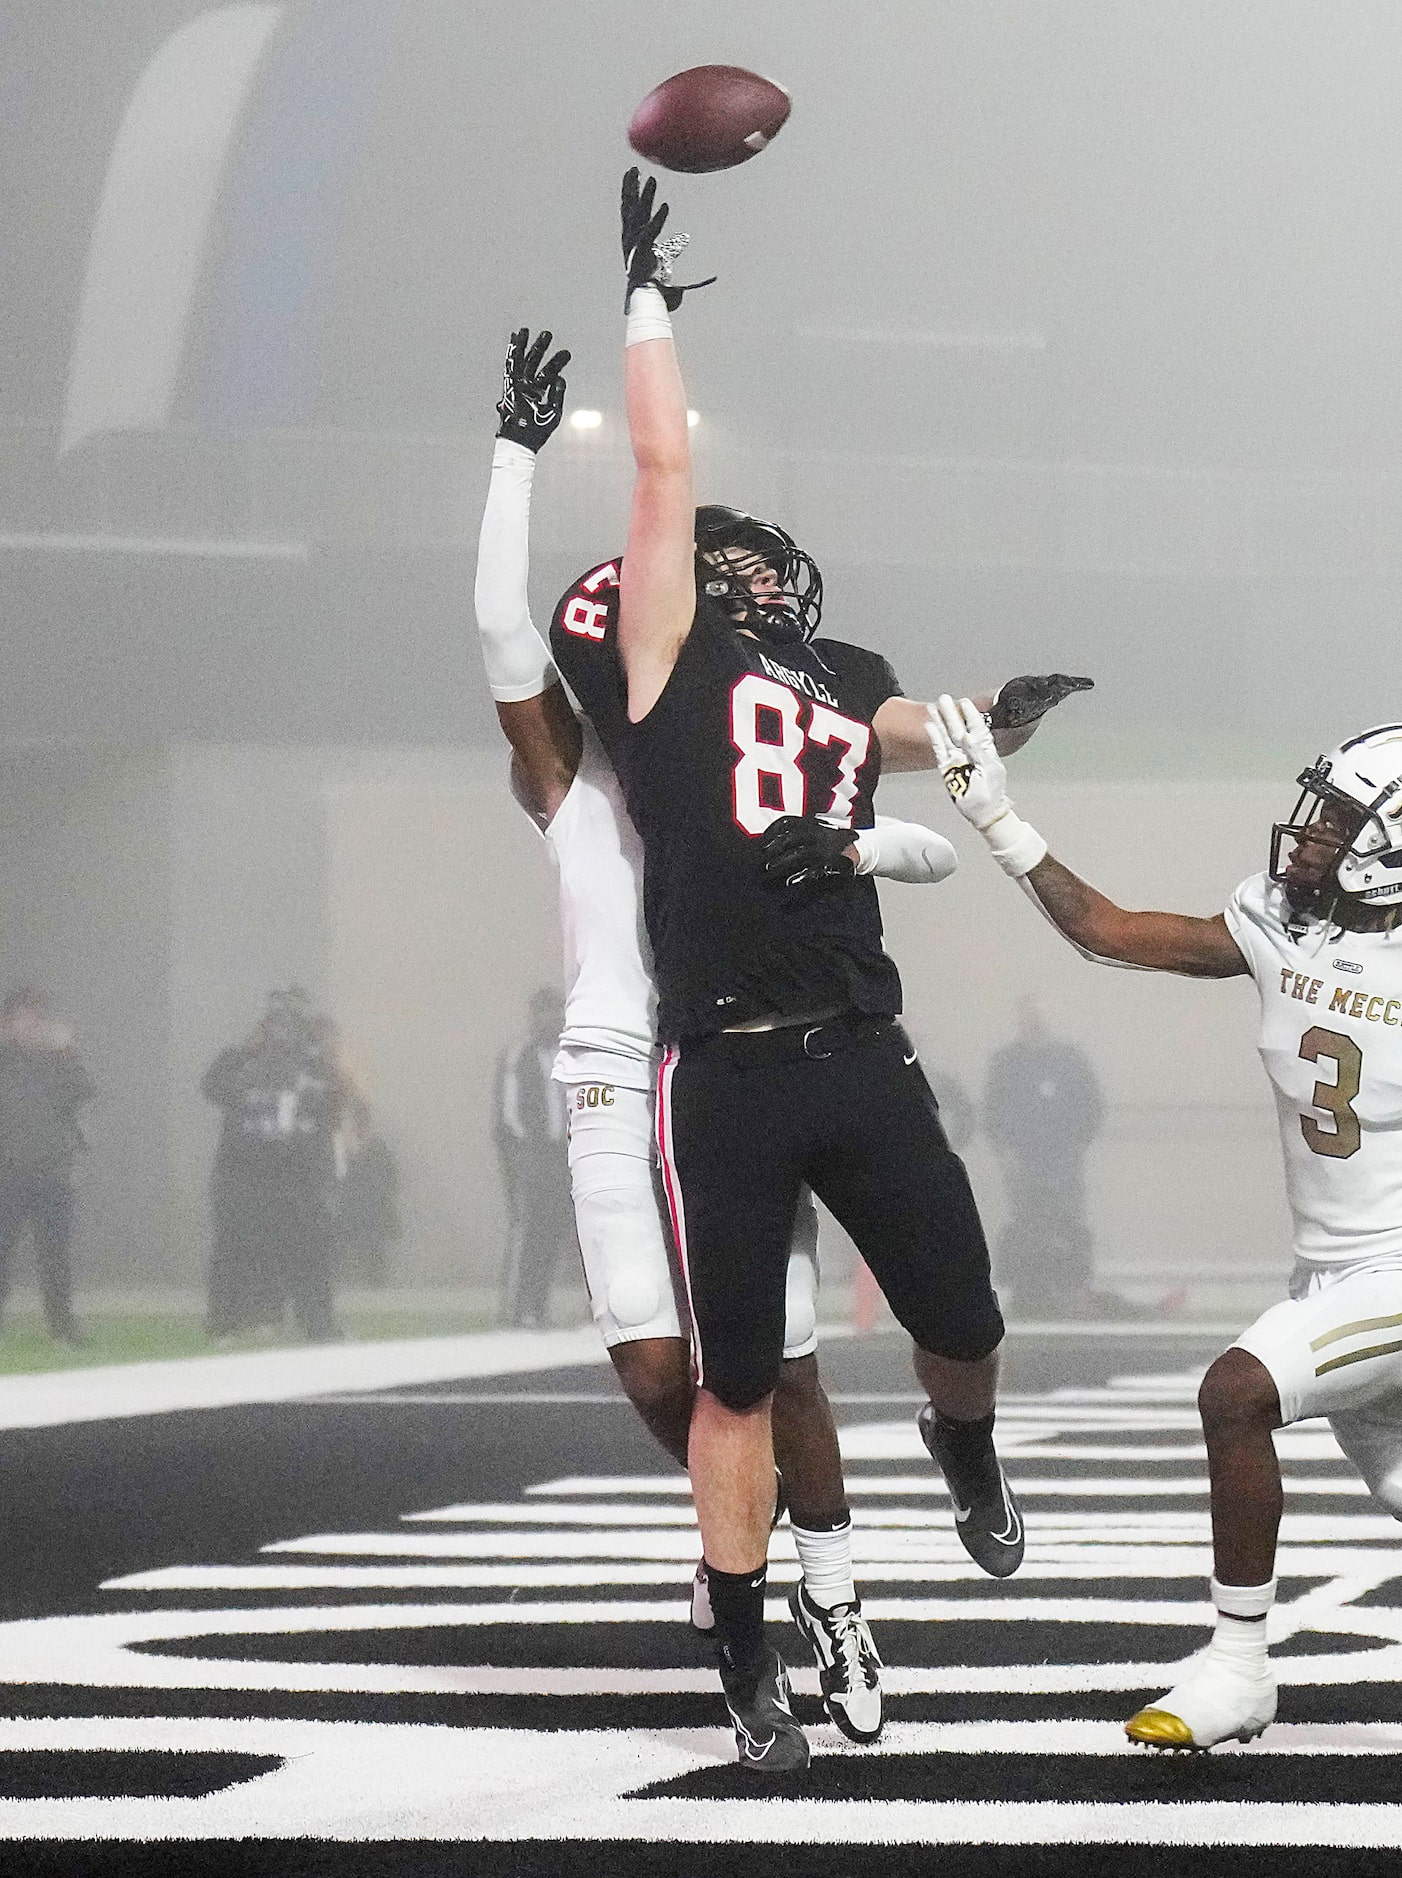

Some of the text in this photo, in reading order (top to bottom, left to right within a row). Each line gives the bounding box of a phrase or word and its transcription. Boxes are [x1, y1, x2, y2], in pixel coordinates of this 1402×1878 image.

[729, 671, 873, 838] 87
[1280, 968, 1324, 1004] THE
[576, 1085, 616, 1110] SOC
[1298, 1026, 1363, 1160] 3
